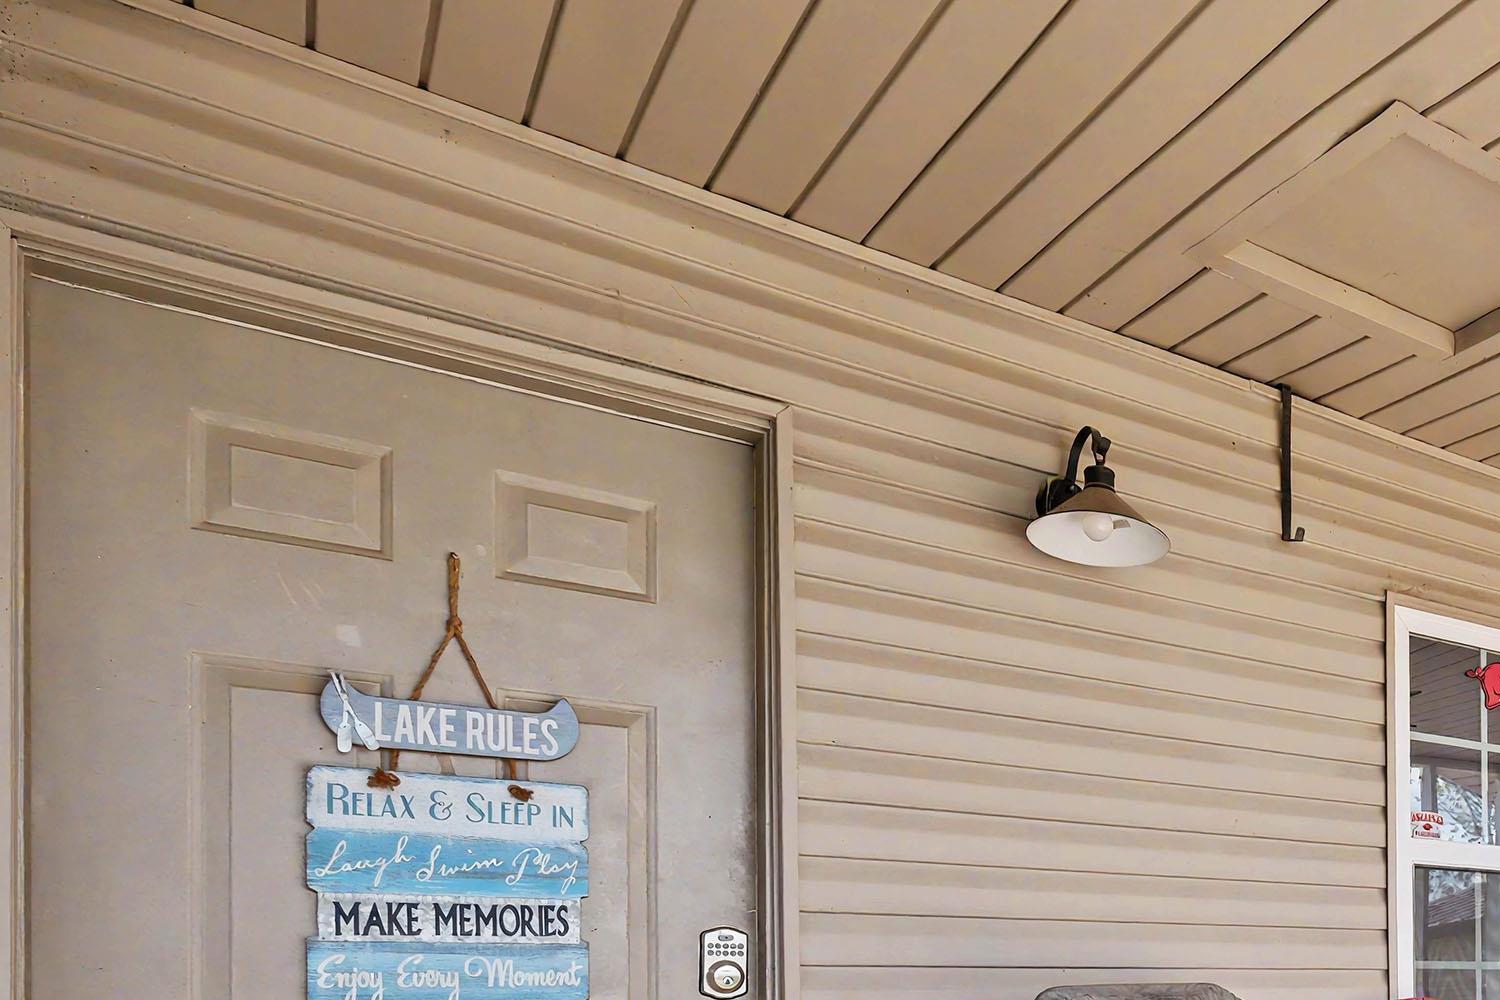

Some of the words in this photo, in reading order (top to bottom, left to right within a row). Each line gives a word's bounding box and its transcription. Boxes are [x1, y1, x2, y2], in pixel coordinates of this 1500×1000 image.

[374, 701, 457, 749] LAKE
[466, 711, 560, 756] RULES
[326, 782, 415, 820] RELAX
[429, 790, 453, 821] &
[465, 792, 542, 825] SLEEP
[552, 806, 574, 828] IN
[314, 836, 416, 887] Laugh
[416, 844, 504, 882] Swim
[505, 847, 580, 896] Play
[332, 902, 421, 937] MAKE
[432, 902, 570, 937] MEMORIES
[464, 956, 584, 988] Moment
